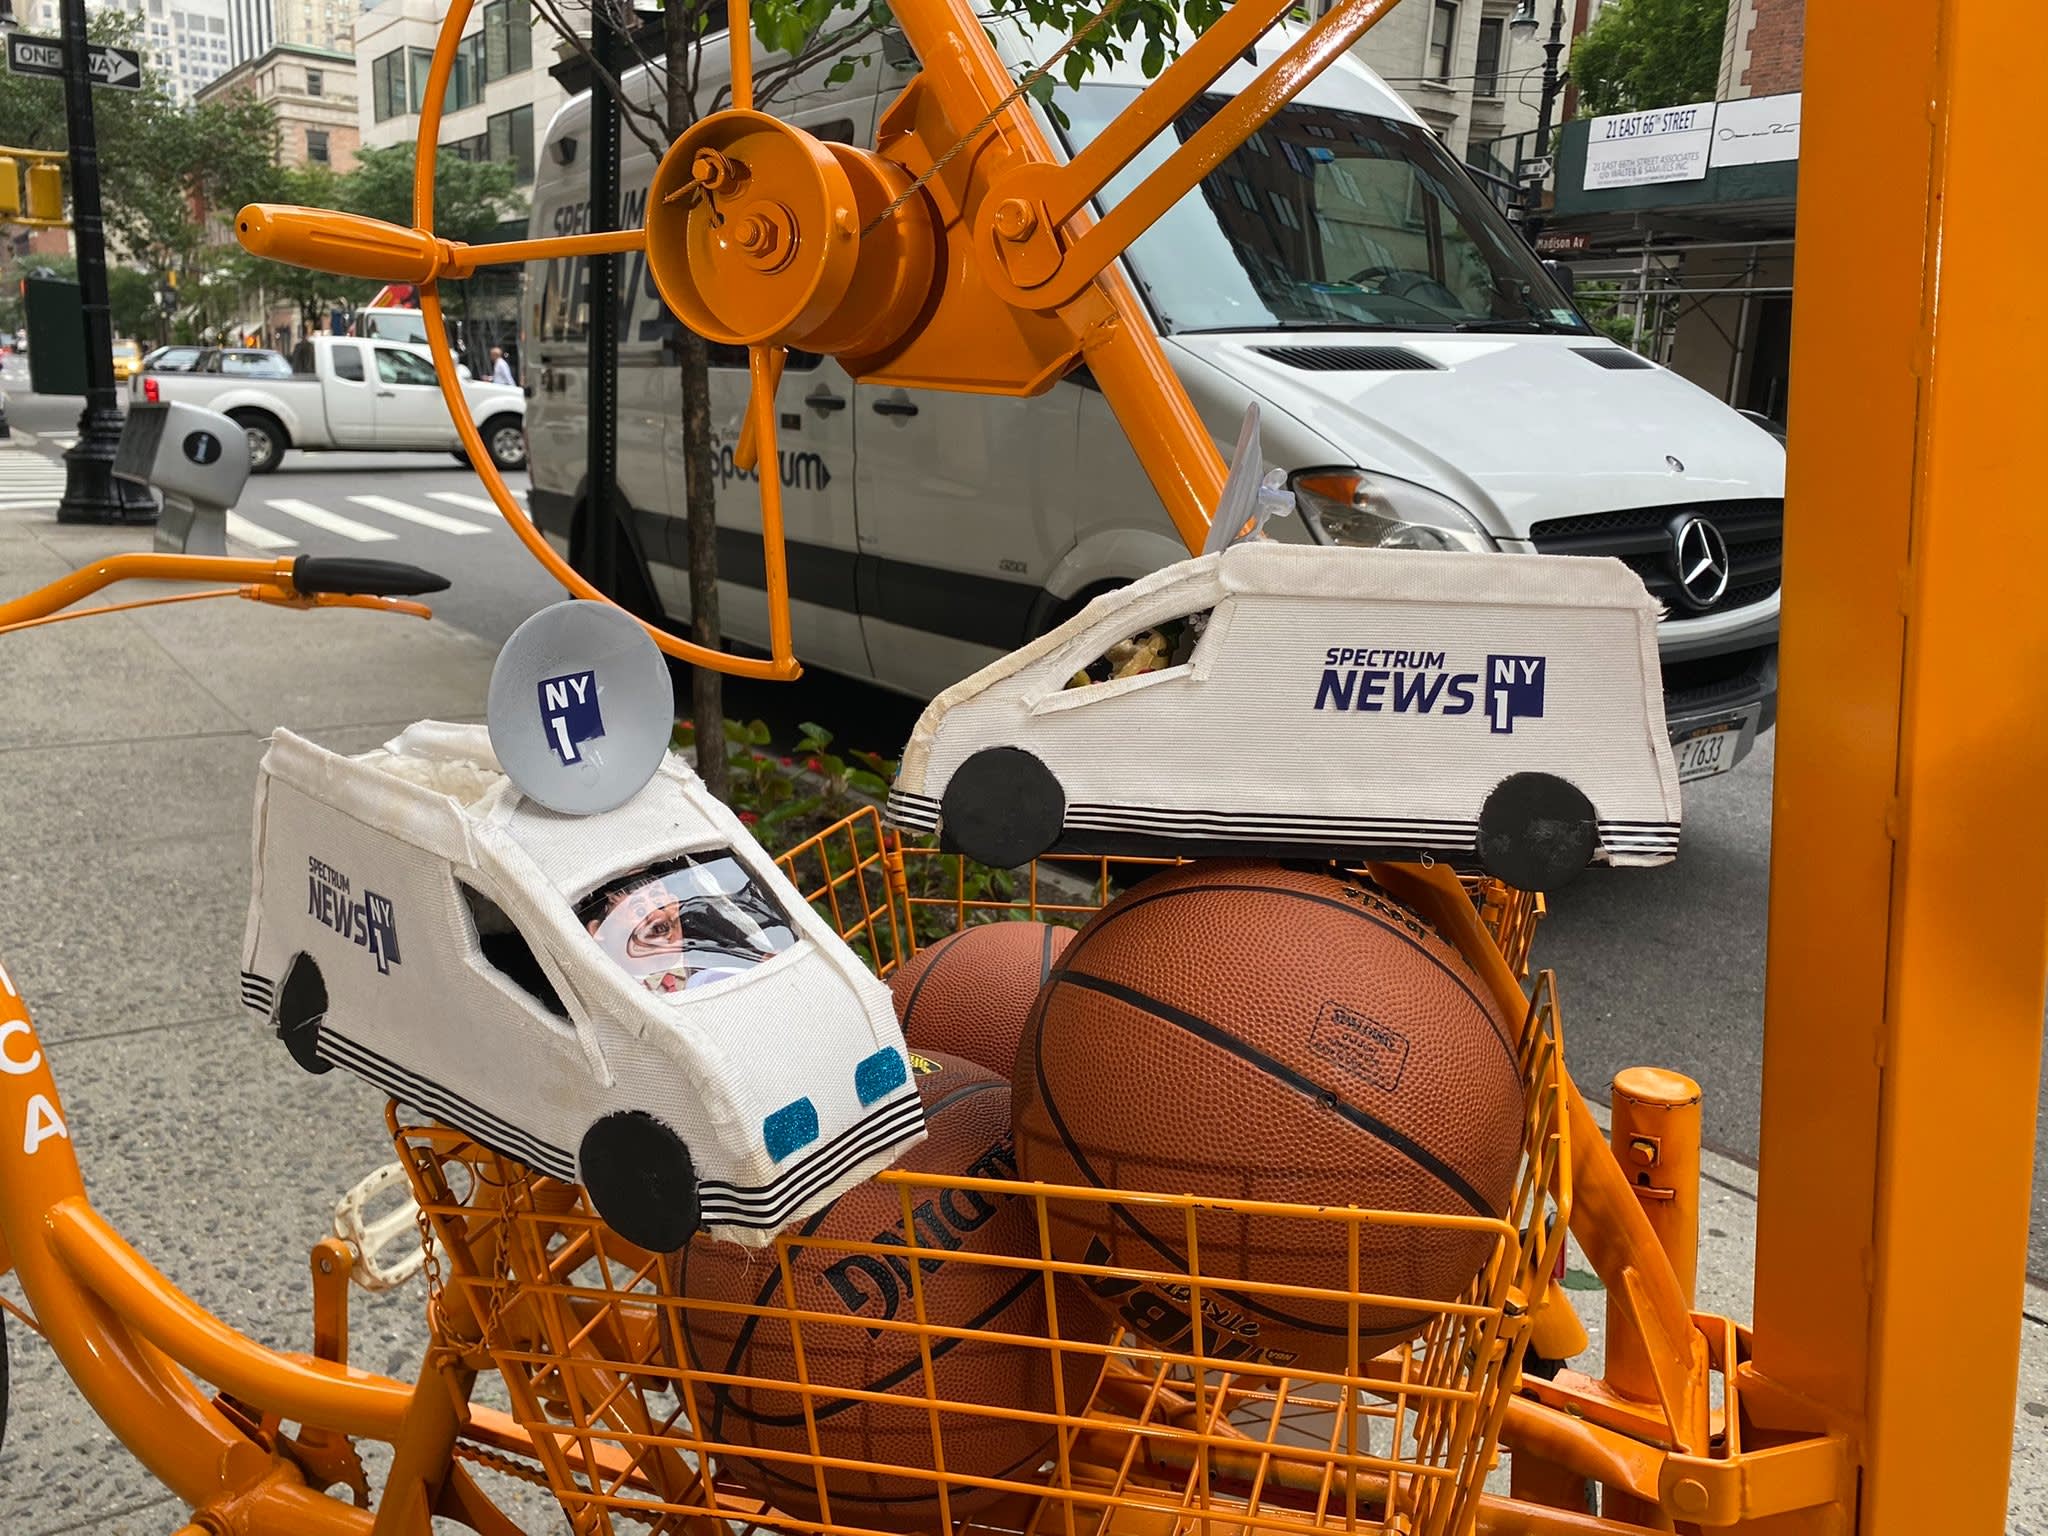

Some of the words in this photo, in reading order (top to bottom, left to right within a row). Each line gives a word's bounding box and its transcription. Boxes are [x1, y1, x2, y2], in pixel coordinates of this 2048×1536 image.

[20, 45, 59, 66] ONE
[1606, 120, 1617, 138] 21
[1619, 117, 1642, 137] EAST
[1661, 110, 1697, 132] STREET
[1537, 238, 1570, 249] Madison
[1573, 237, 1584, 248] Av
[1325, 647, 1446, 669] SPECTRUM
[545, 675, 589, 712] NY
[1313, 669, 1479, 715] NEWS
[1494, 659, 1540, 685] NY
[1494, 690, 1509, 729] 1
[551, 716, 576, 761] 1
[1690, 735, 1724, 768] 7633
[308, 856, 350, 895] SPECTRUM
[308, 875, 368, 947] NEWS
[369, 895, 390, 928] NY
[374, 928, 386, 970] 1
